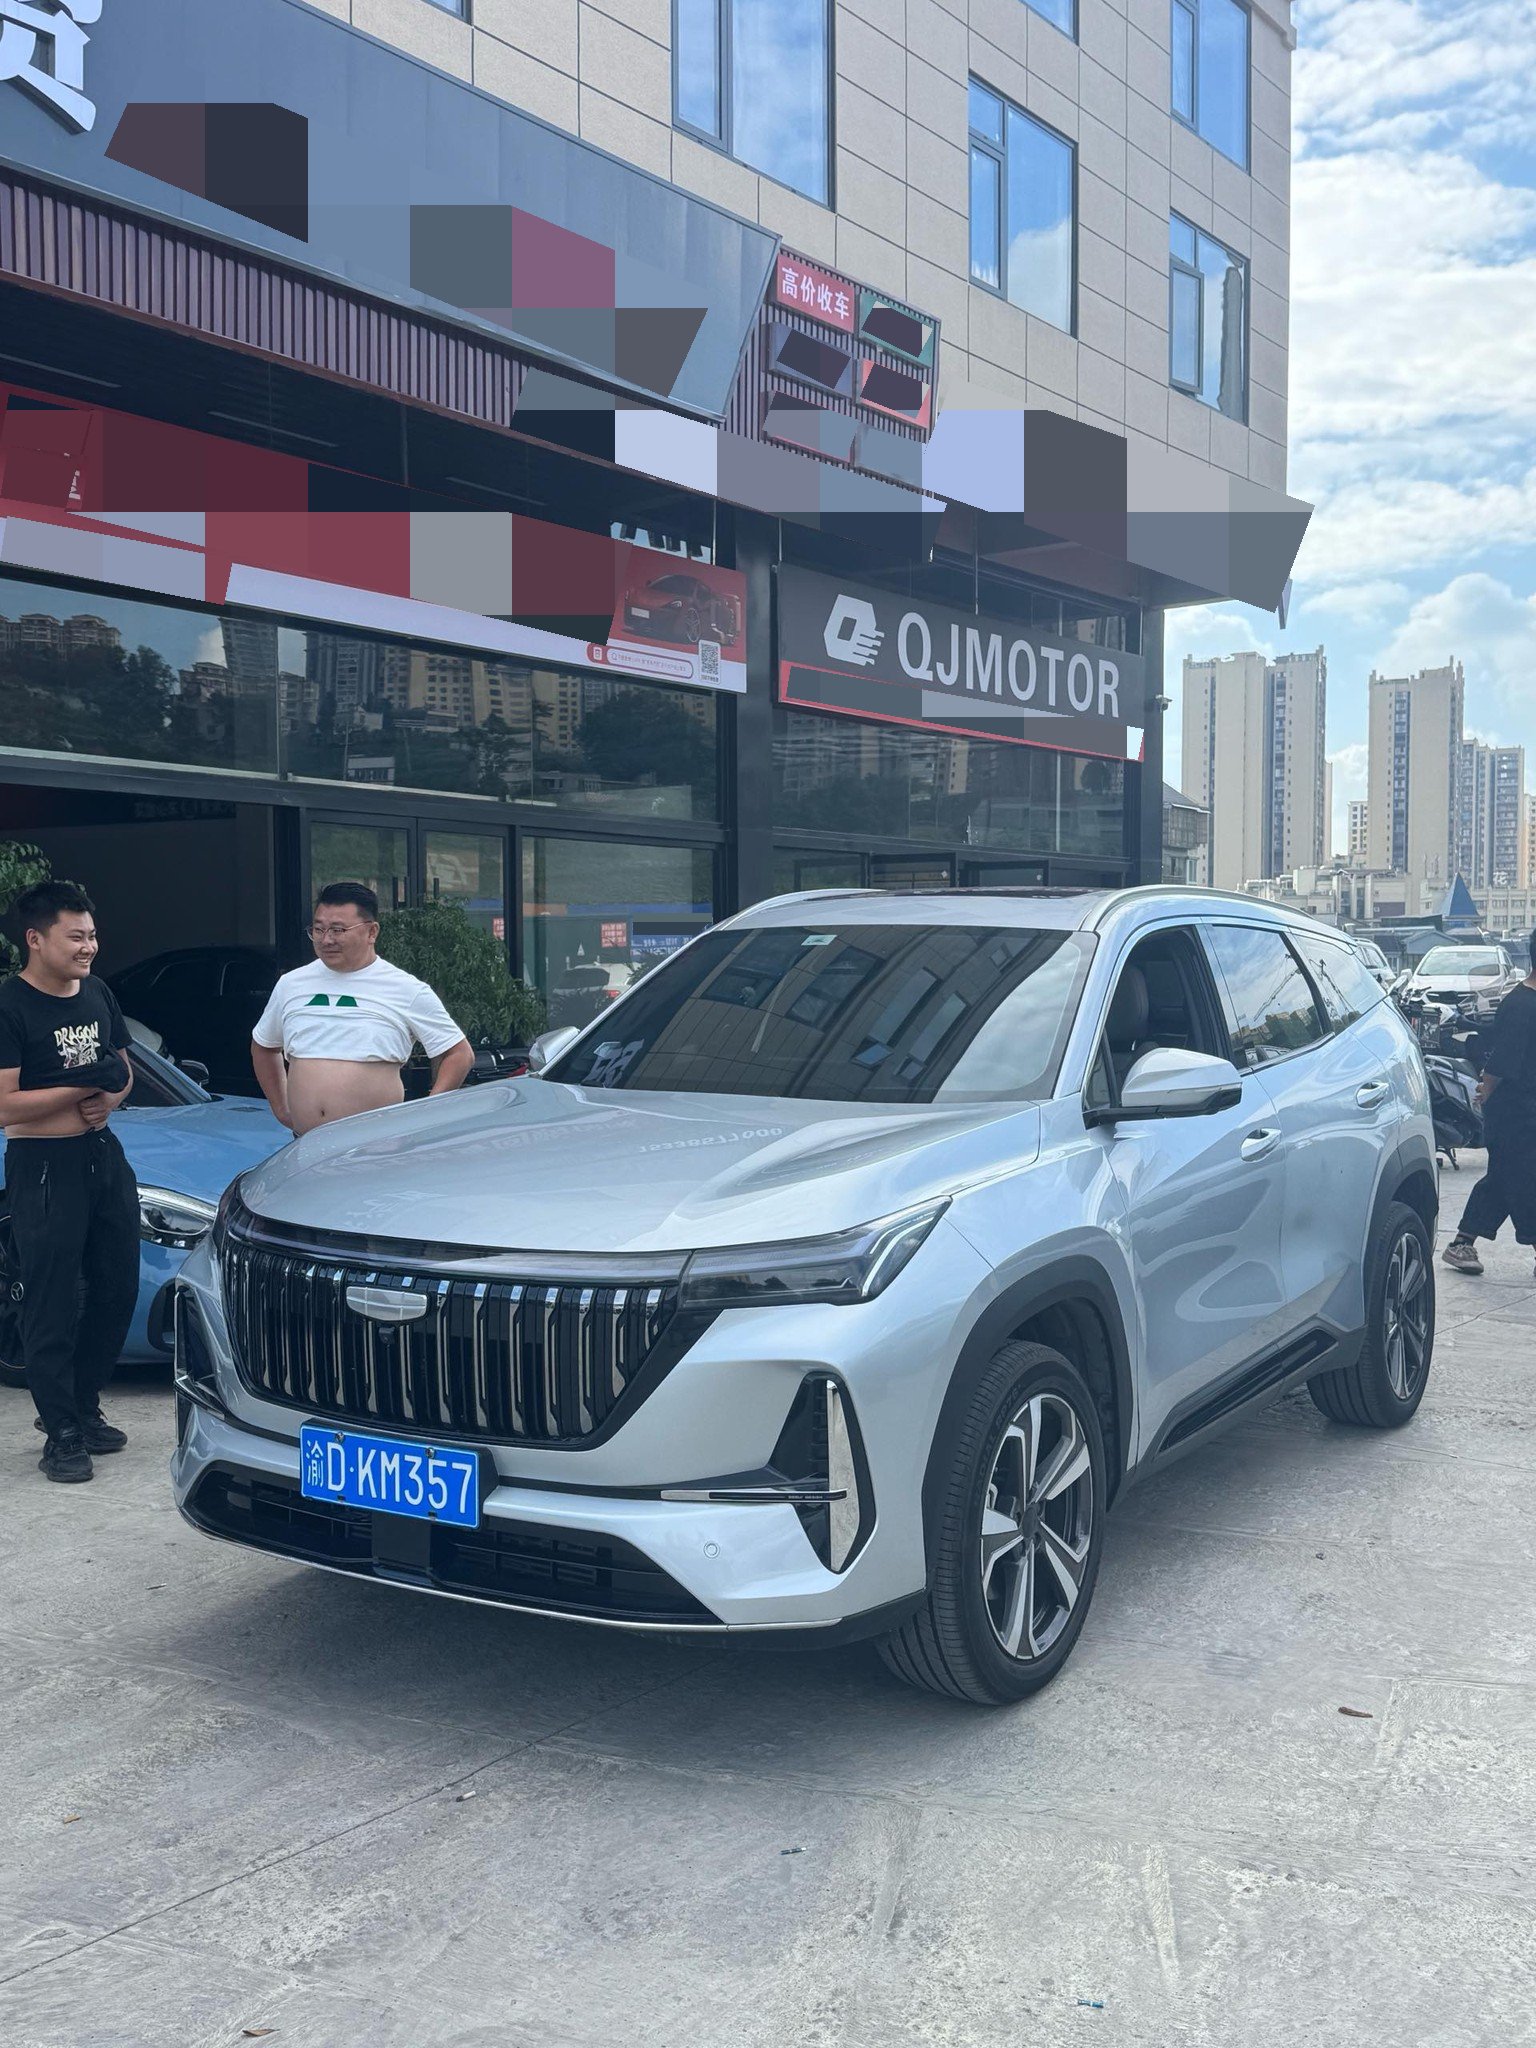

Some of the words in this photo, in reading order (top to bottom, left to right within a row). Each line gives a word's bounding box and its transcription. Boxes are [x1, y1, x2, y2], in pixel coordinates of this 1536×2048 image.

[781, 267, 850, 320] 高价收车
[897, 611, 1120, 719] QJMOTOR
[53, 1020, 99, 1047] DRAGON
